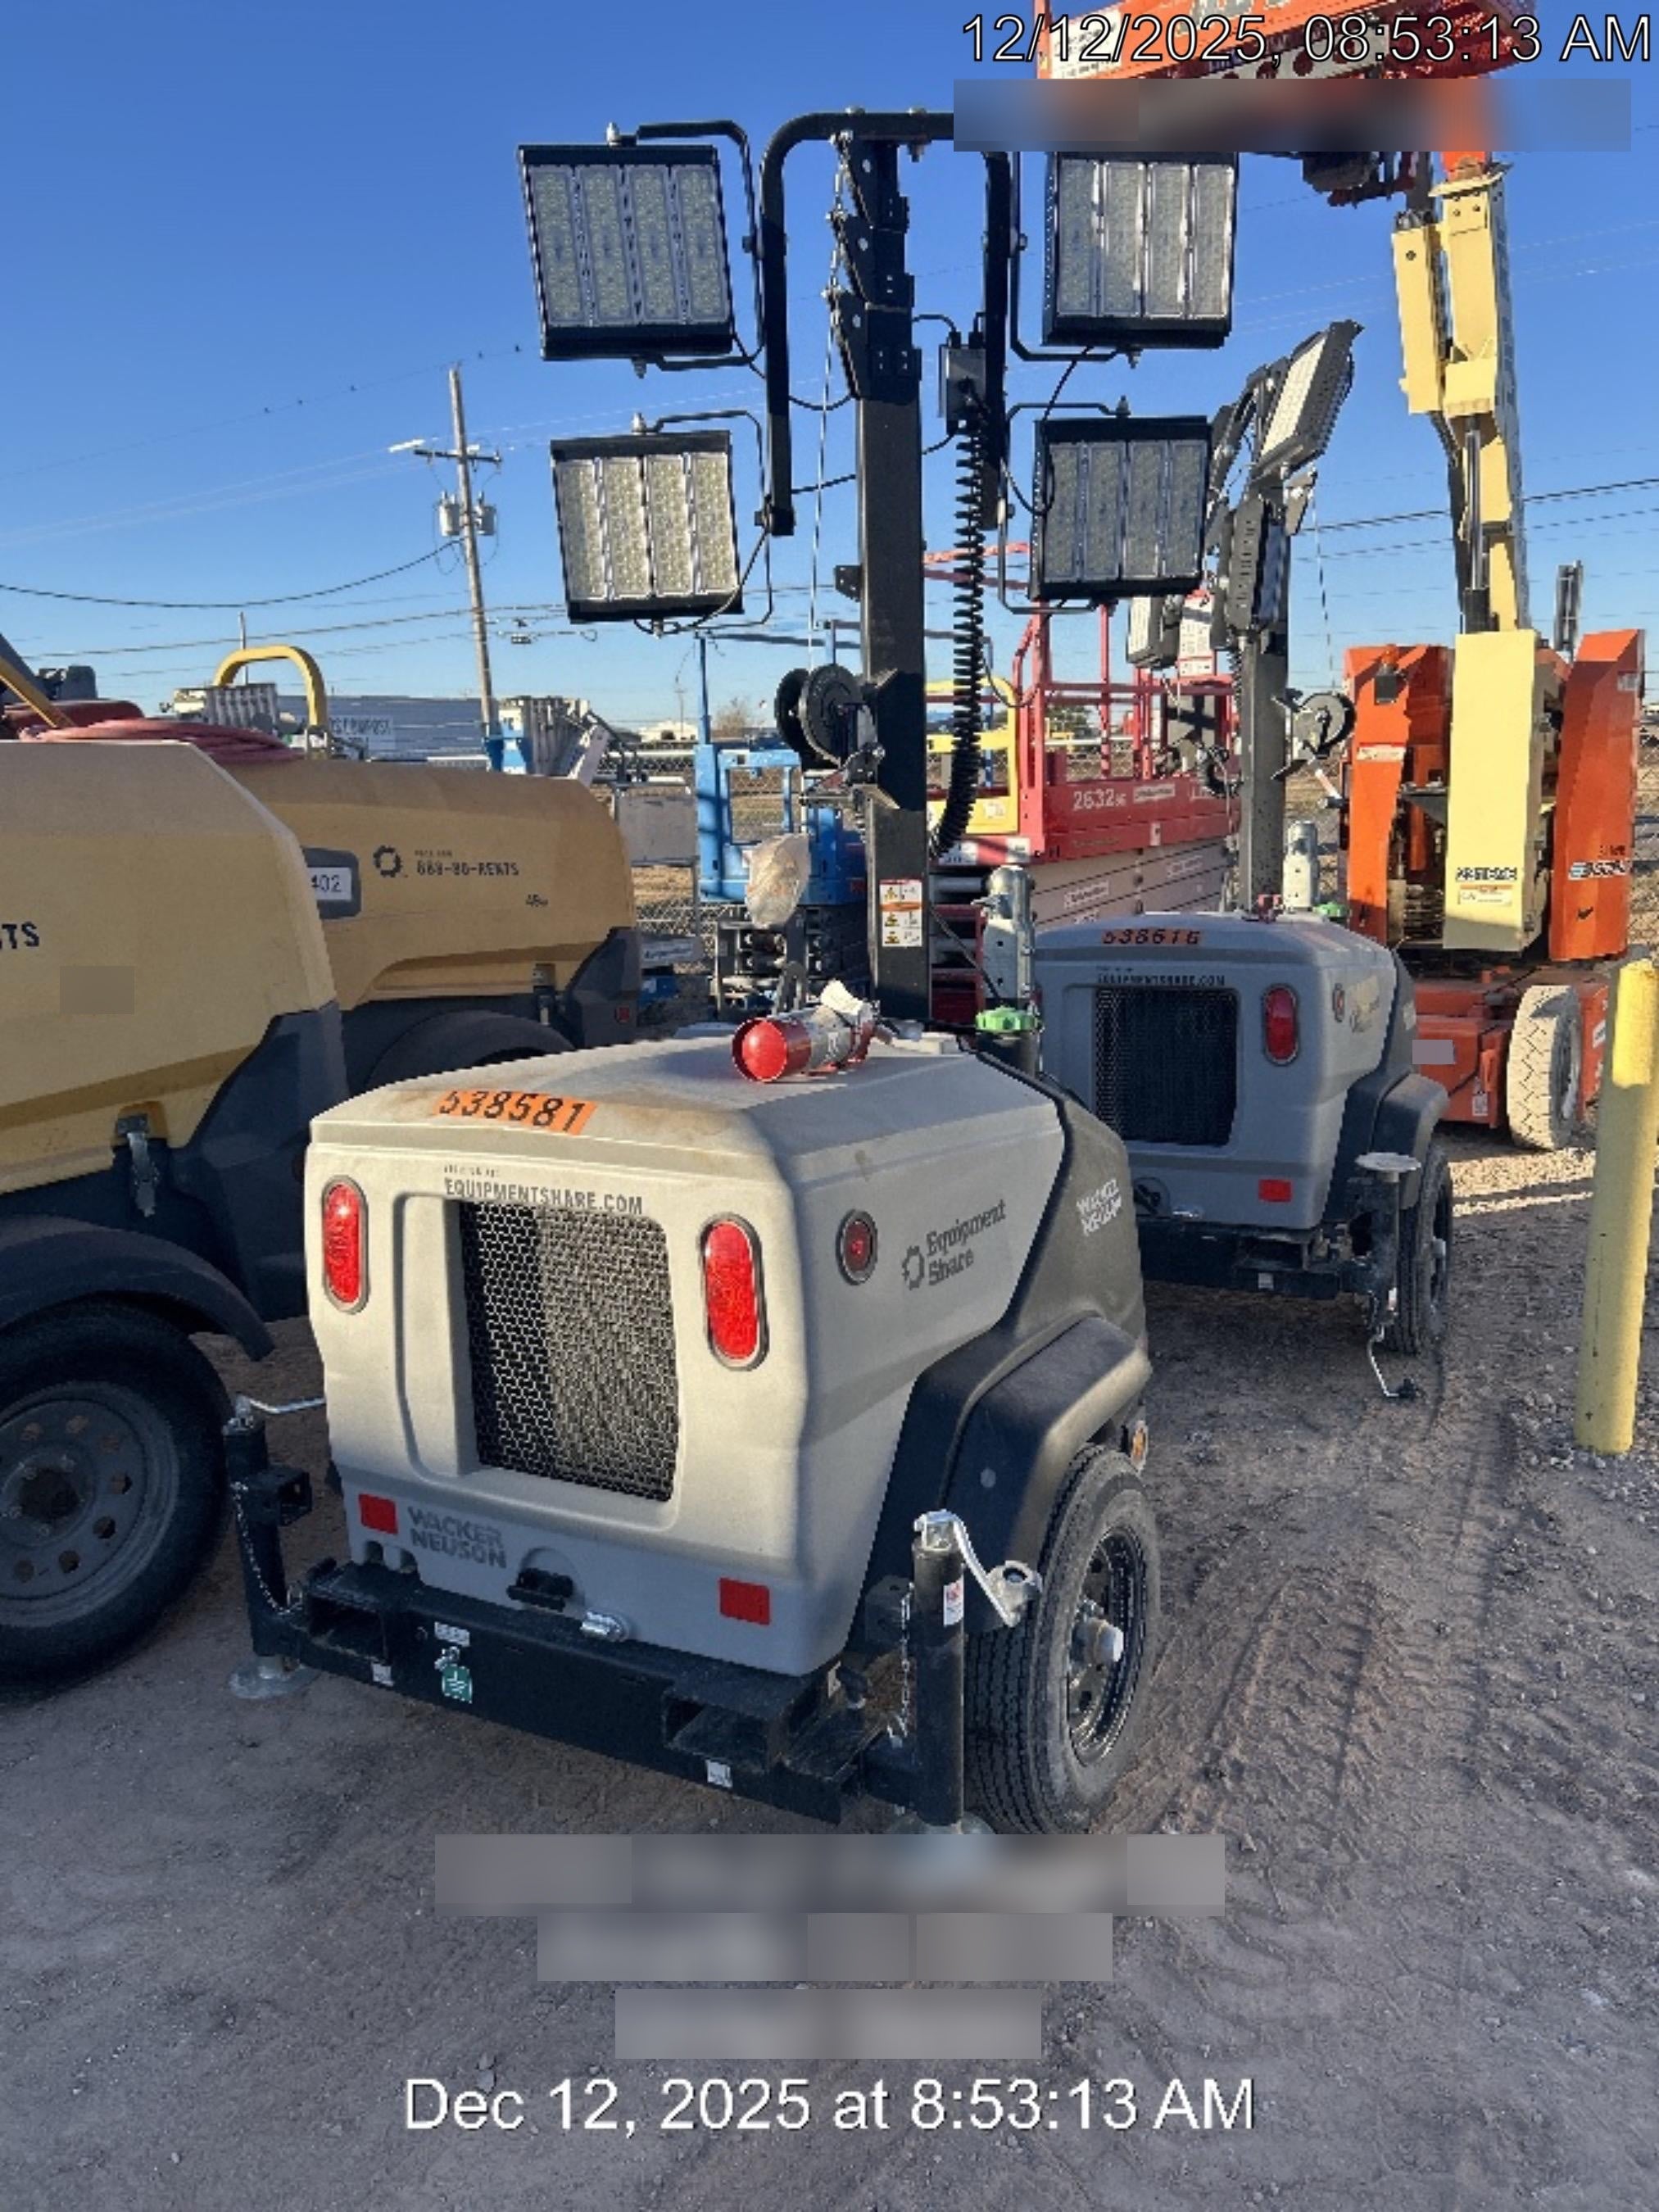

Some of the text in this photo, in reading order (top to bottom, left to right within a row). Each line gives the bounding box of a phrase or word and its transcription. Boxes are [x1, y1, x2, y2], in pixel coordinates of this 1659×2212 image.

[0, 921, 39, 949] TS
[439, 1090, 585, 1131] 538581
[444, 1176, 643, 1214] EQUIPMENTSHARE.COM
[926, 1199, 1007, 1257] Equipment
[927, 1248, 974, 1285] Share
[407, 1506, 504, 1549] WACKER
[410, 1527, 506, 1568] NEUSON
